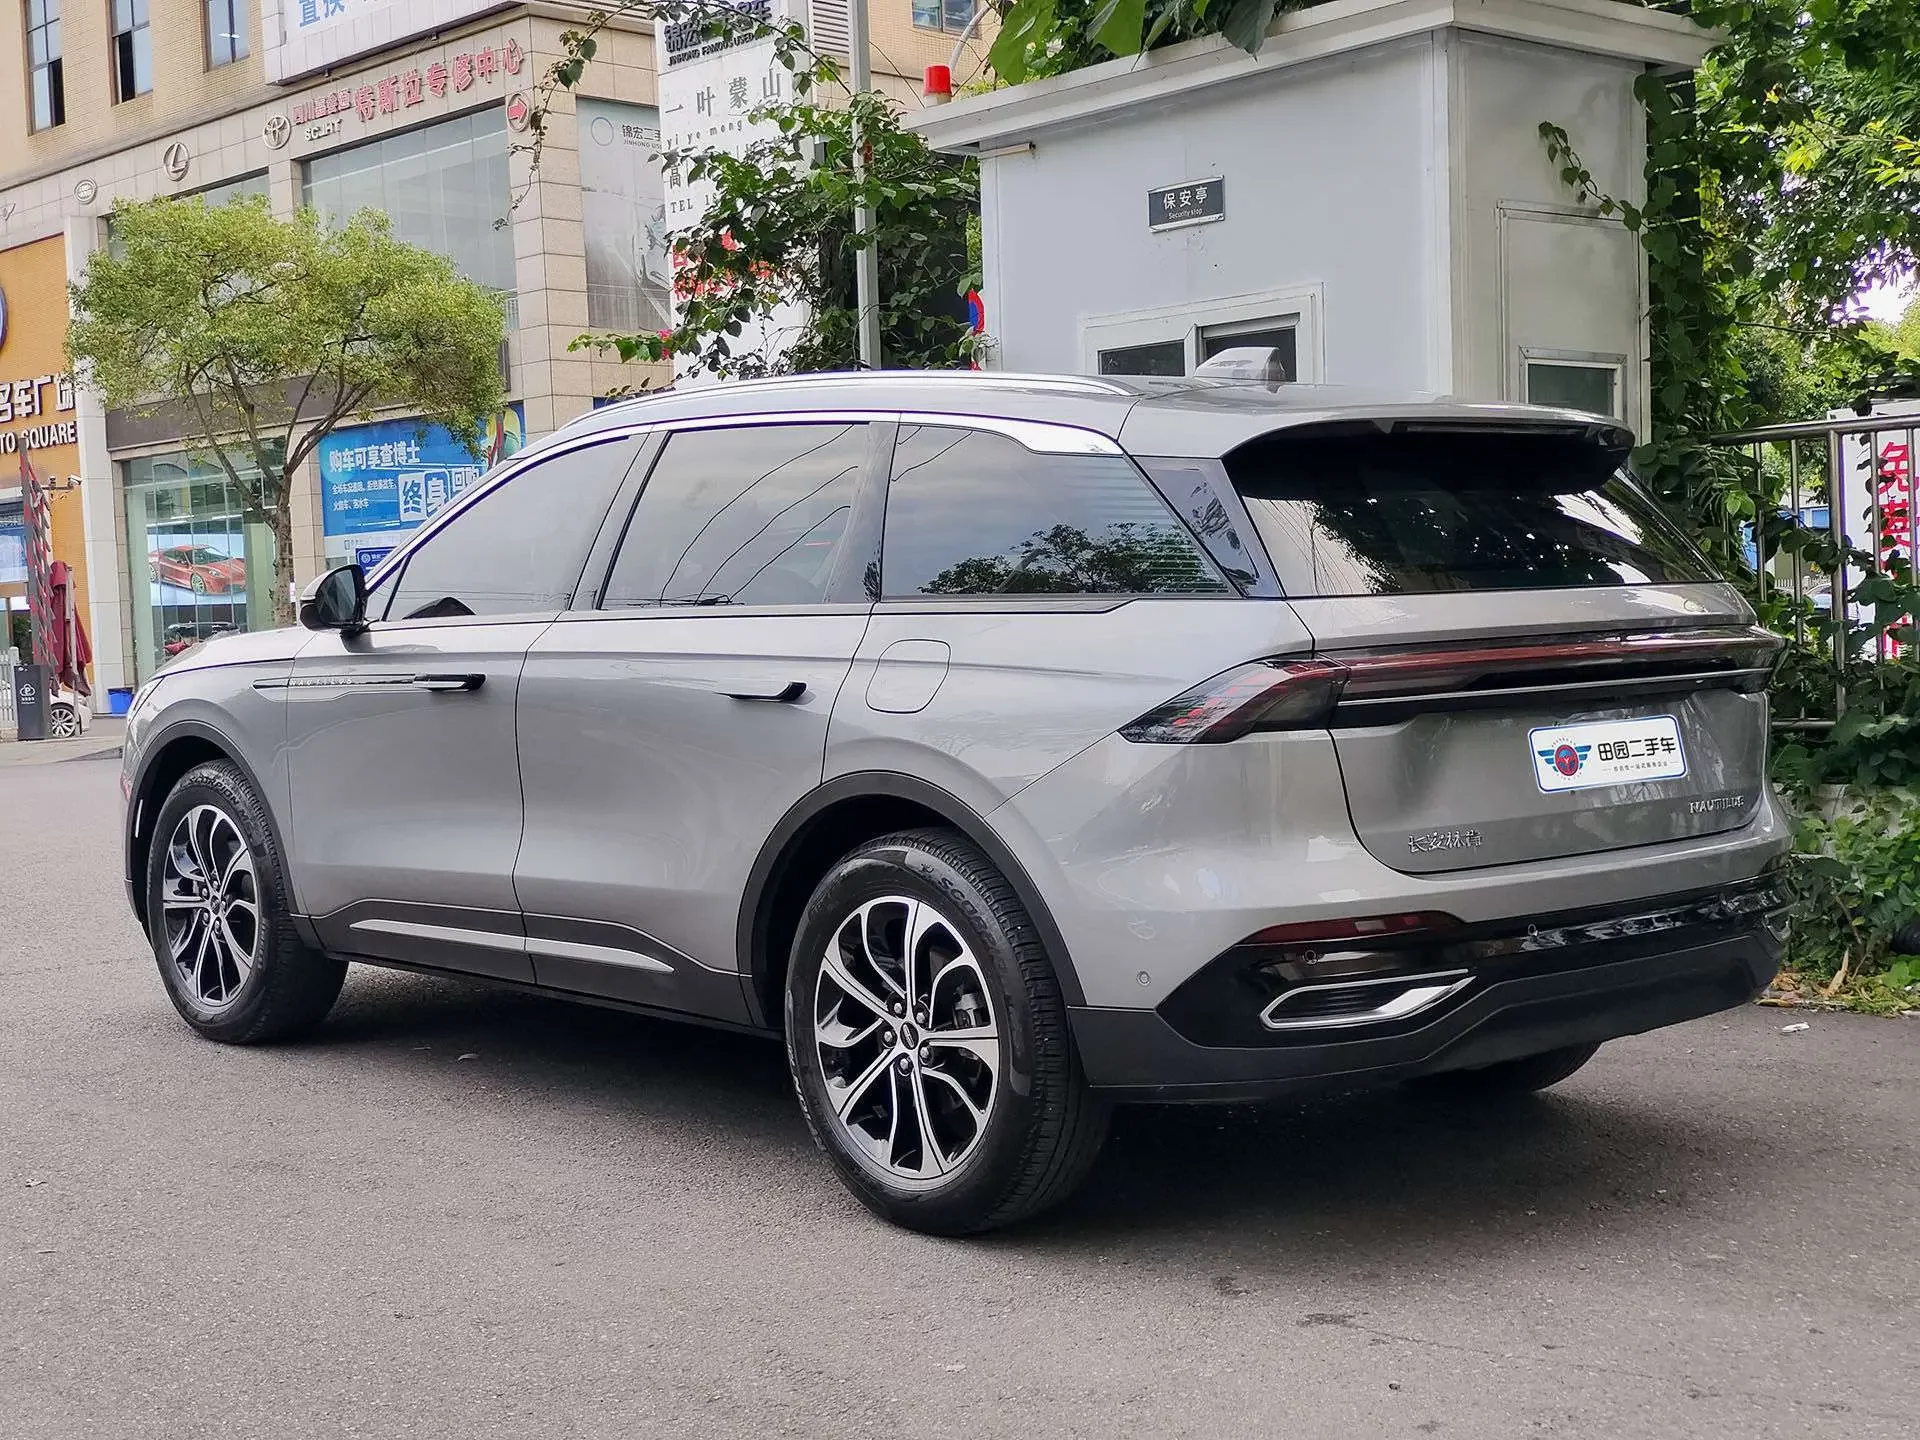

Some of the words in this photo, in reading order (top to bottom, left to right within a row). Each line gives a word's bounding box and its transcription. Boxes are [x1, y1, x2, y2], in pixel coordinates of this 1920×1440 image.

[354, 37, 524, 122] 特斯拉专修中心
[664, 68, 781, 117] 一叶蒙山
[670, 198, 694, 214] TEL
[1163, 186, 1208, 210] 保安亭
[20, 420, 77, 449] SQUARE
[1598, 737, 1676, 762] 田园二手车
[1690, 795, 1745, 814] NAUTILUS
[1408, 829, 1482, 853] 长安林肯
